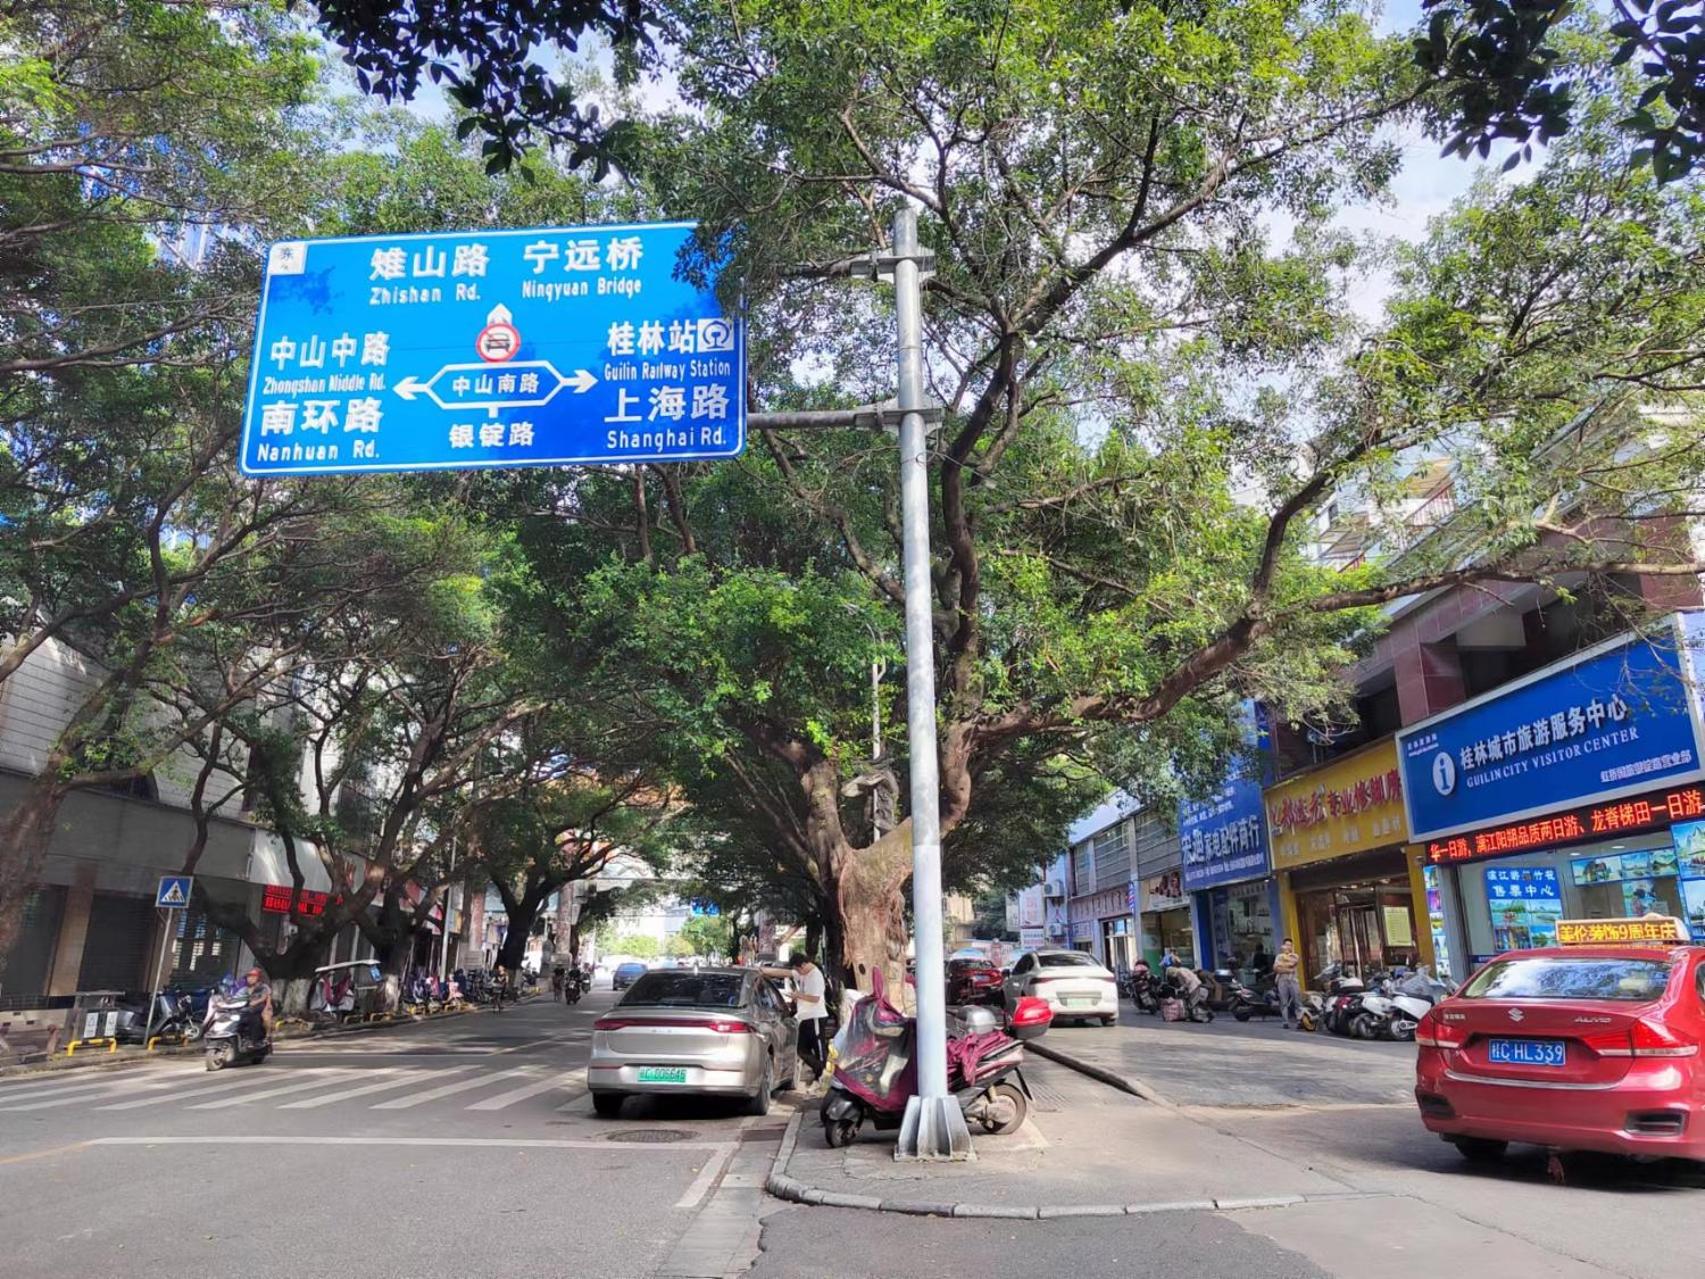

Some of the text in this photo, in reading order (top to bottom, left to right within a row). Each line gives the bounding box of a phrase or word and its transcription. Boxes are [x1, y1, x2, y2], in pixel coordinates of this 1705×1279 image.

[369, 242, 490, 281] 雉山路
[523, 236, 643, 274] 宁远桥
[369, 283, 480, 305] Zhishan Rd.
[522, 277, 642, 300] Ningyuan Bridge
[270, 331, 390, 370] 中山中路
[607, 319, 696, 356] 桂林站
[452, 371, 539, 397] 中山南路
[604, 360, 730, 382] Guilin Railway Station
[263, 372, 386, 398] Zhongshan Middle Rd.
[261, 396, 383, 436] 南环路
[604, 383, 729, 422] 上海路
[449, 421, 534, 448] 银锭路
[607, 427, 727, 453] Shanghai Rd.
[257, 439, 380, 462] Nanhuan Rd.
[1460, 694, 1628, 771] 桂林城市旅游服务中心
[1466, 727, 1640, 788] GUILIN CITY VISITOR CENTER
[1492, 884, 1555, 898] 售票中心
